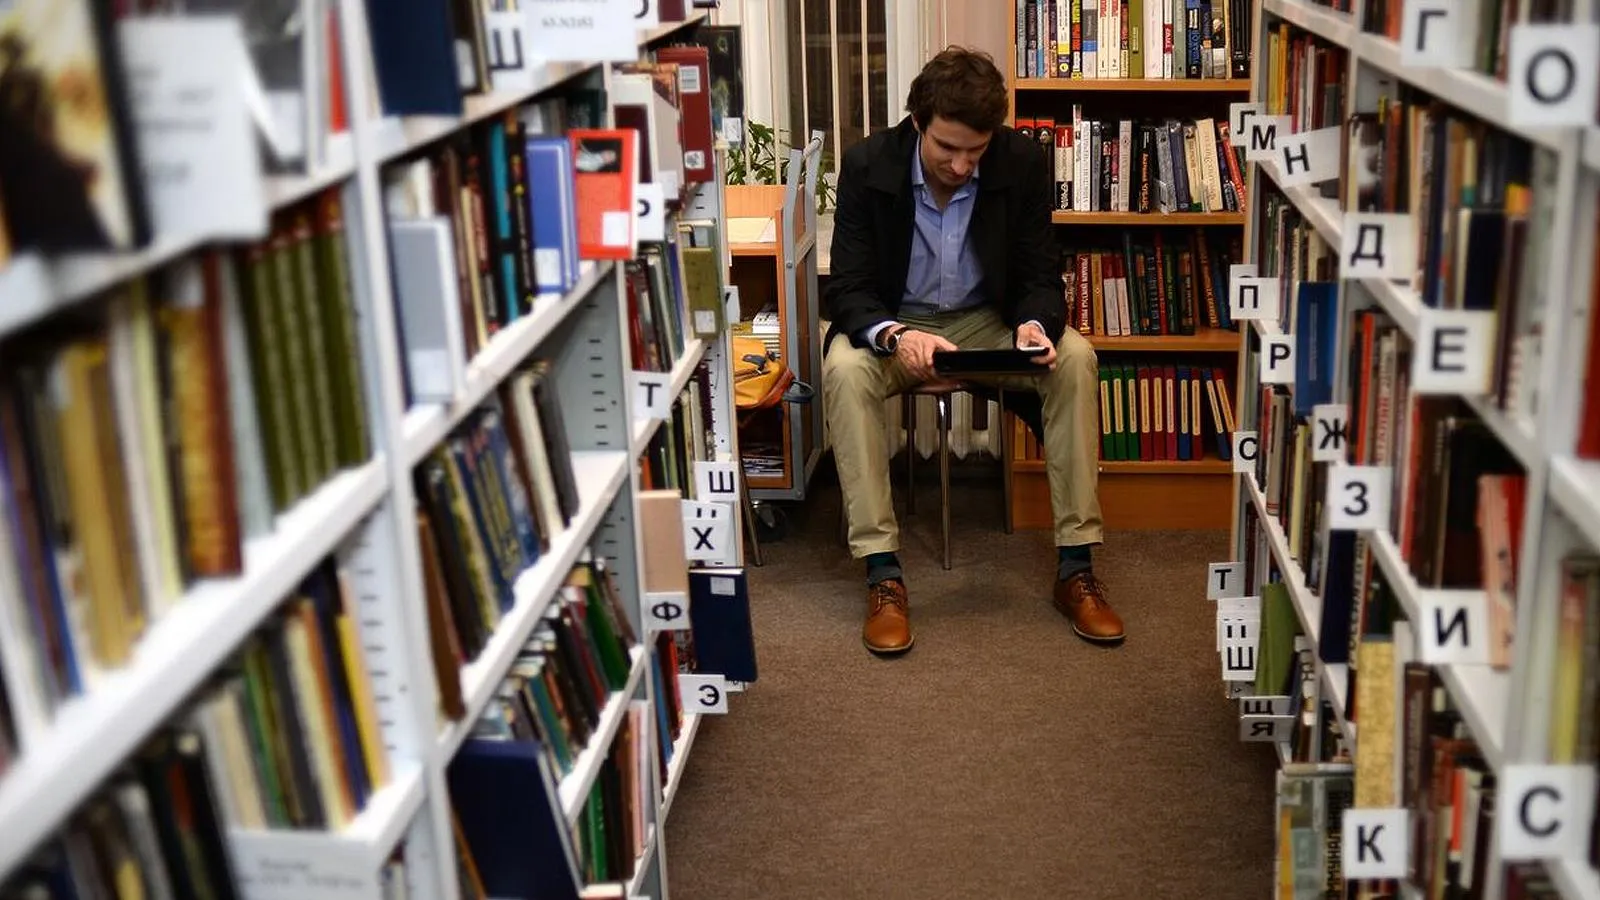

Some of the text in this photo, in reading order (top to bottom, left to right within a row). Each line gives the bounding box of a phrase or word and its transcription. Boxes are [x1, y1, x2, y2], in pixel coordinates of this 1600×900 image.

[1416, 9, 1448, 52] Г
[1524, 46, 1577, 106] О
[1252, 125, 1276, 150] М
[1284, 143, 1310, 175] Н
[1350, 223, 1384, 268] Д
[1239, 285, 1258, 308] П
[1270, 343, 1291, 370] Р
[1431, 327, 1467, 372] Е
[639, 382, 662, 407] Т
[1318, 418, 1346, 449] Ж
[1239, 437, 1257, 460] С
[709, 471, 735, 493] Ш
[1344, 481, 1369, 516] З
[692, 527, 714, 550] Х
[1215, 568, 1232, 590] Т
[652, 602, 682, 621] Ф
[1435, 607, 1469, 648] И
[1228, 647, 1254, 670] Ш
[699, 685, 720, 706] Э
[1250, 721, 1275, 737] Я
[1518, 785, 1562, 839] С
[1358, 825, 1385, 863] К
